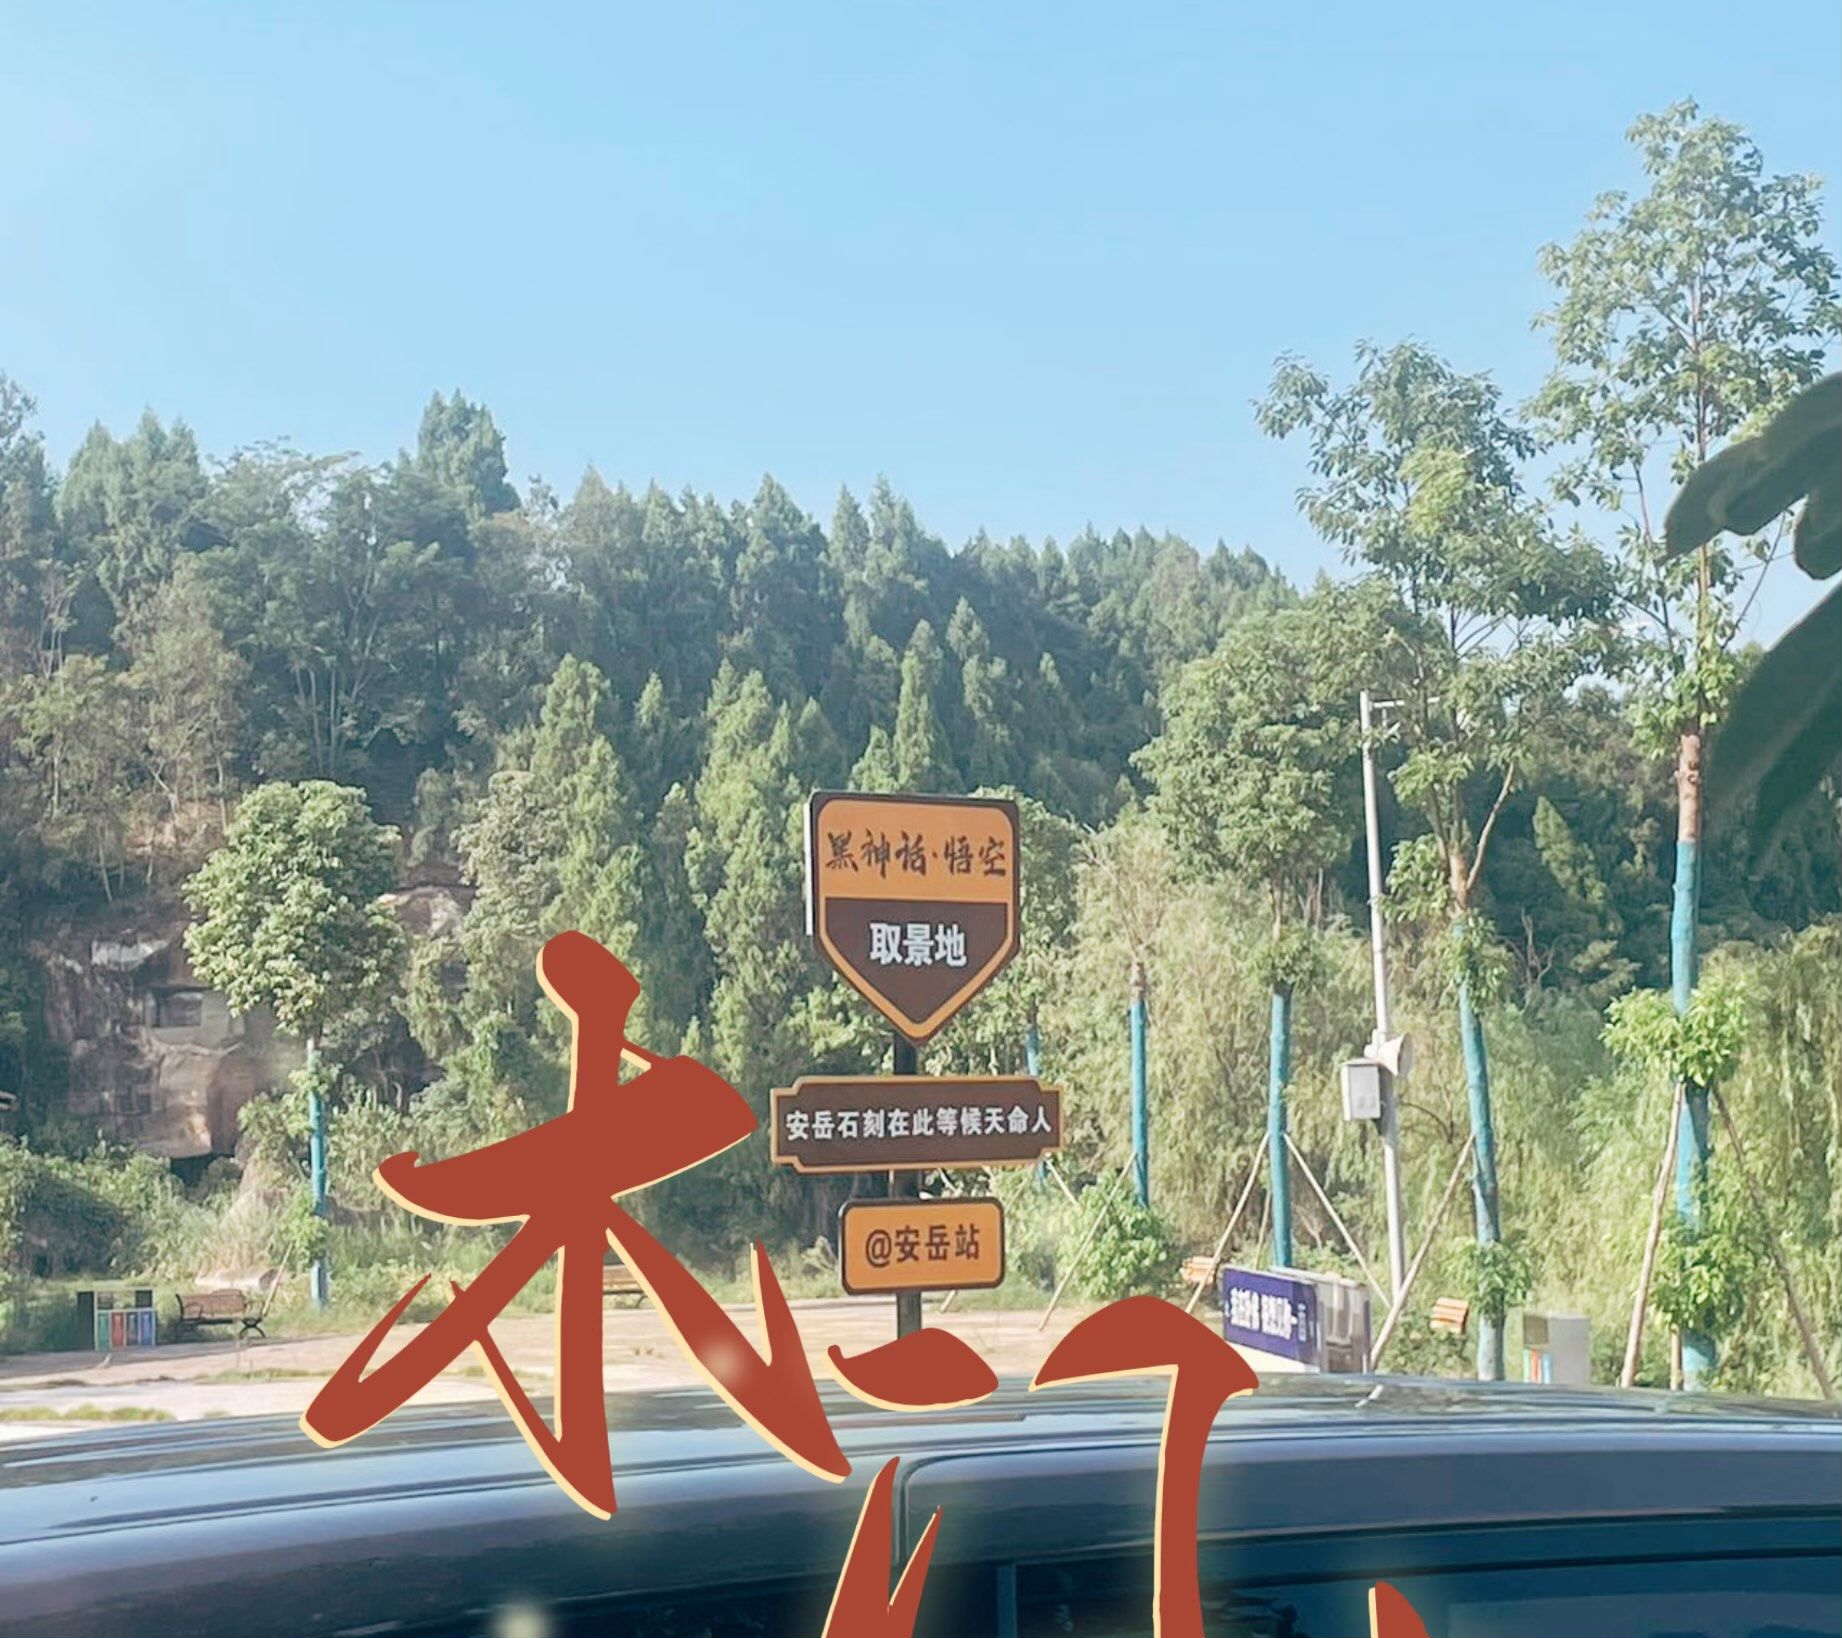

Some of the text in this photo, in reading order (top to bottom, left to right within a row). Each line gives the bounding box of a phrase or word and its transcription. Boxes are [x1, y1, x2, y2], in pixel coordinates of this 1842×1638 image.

[869, 922, 967, 967] 取景地
[785, 1105, 1052, 1141] 安岳石刻在此等候天命人
[865, 1223, 980, 1268] @安岳站
